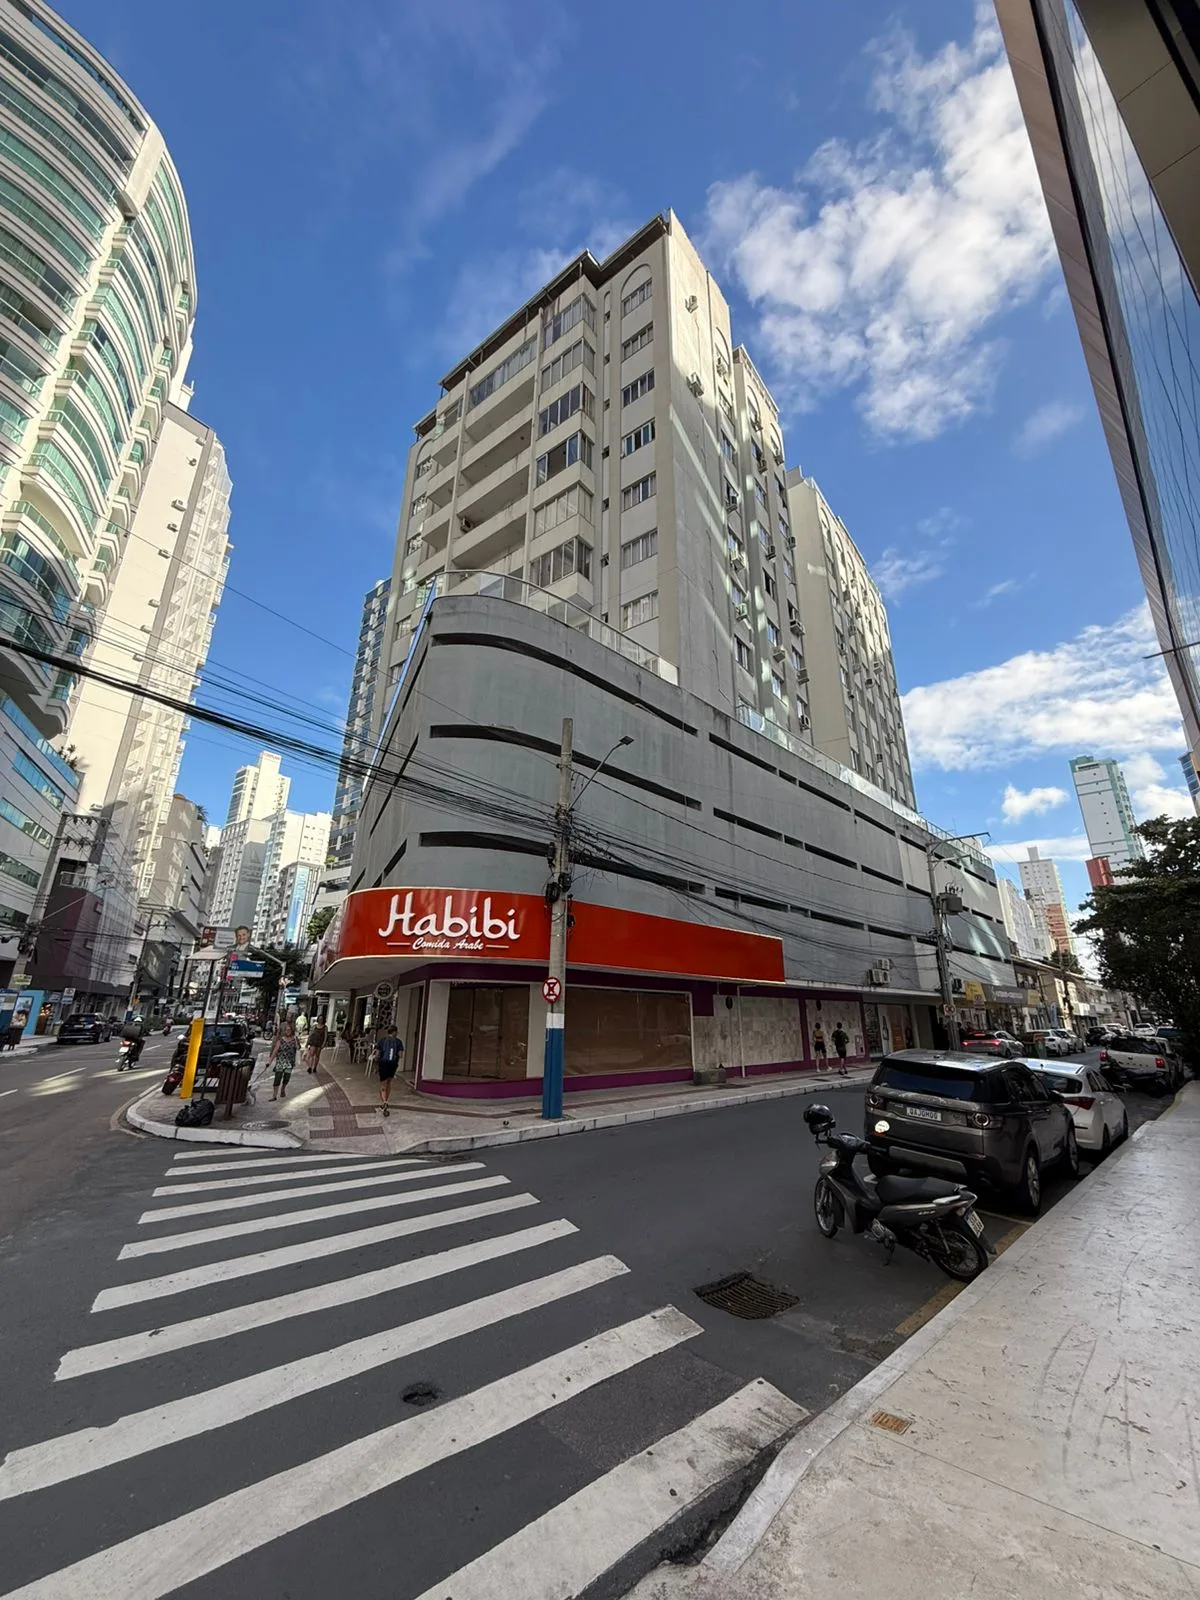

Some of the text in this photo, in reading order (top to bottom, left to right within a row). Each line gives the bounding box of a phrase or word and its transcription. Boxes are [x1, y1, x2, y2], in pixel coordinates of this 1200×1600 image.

[378, 891, 521, 941] Habibi
[412, 934, 484, 950] Comida Árabe
